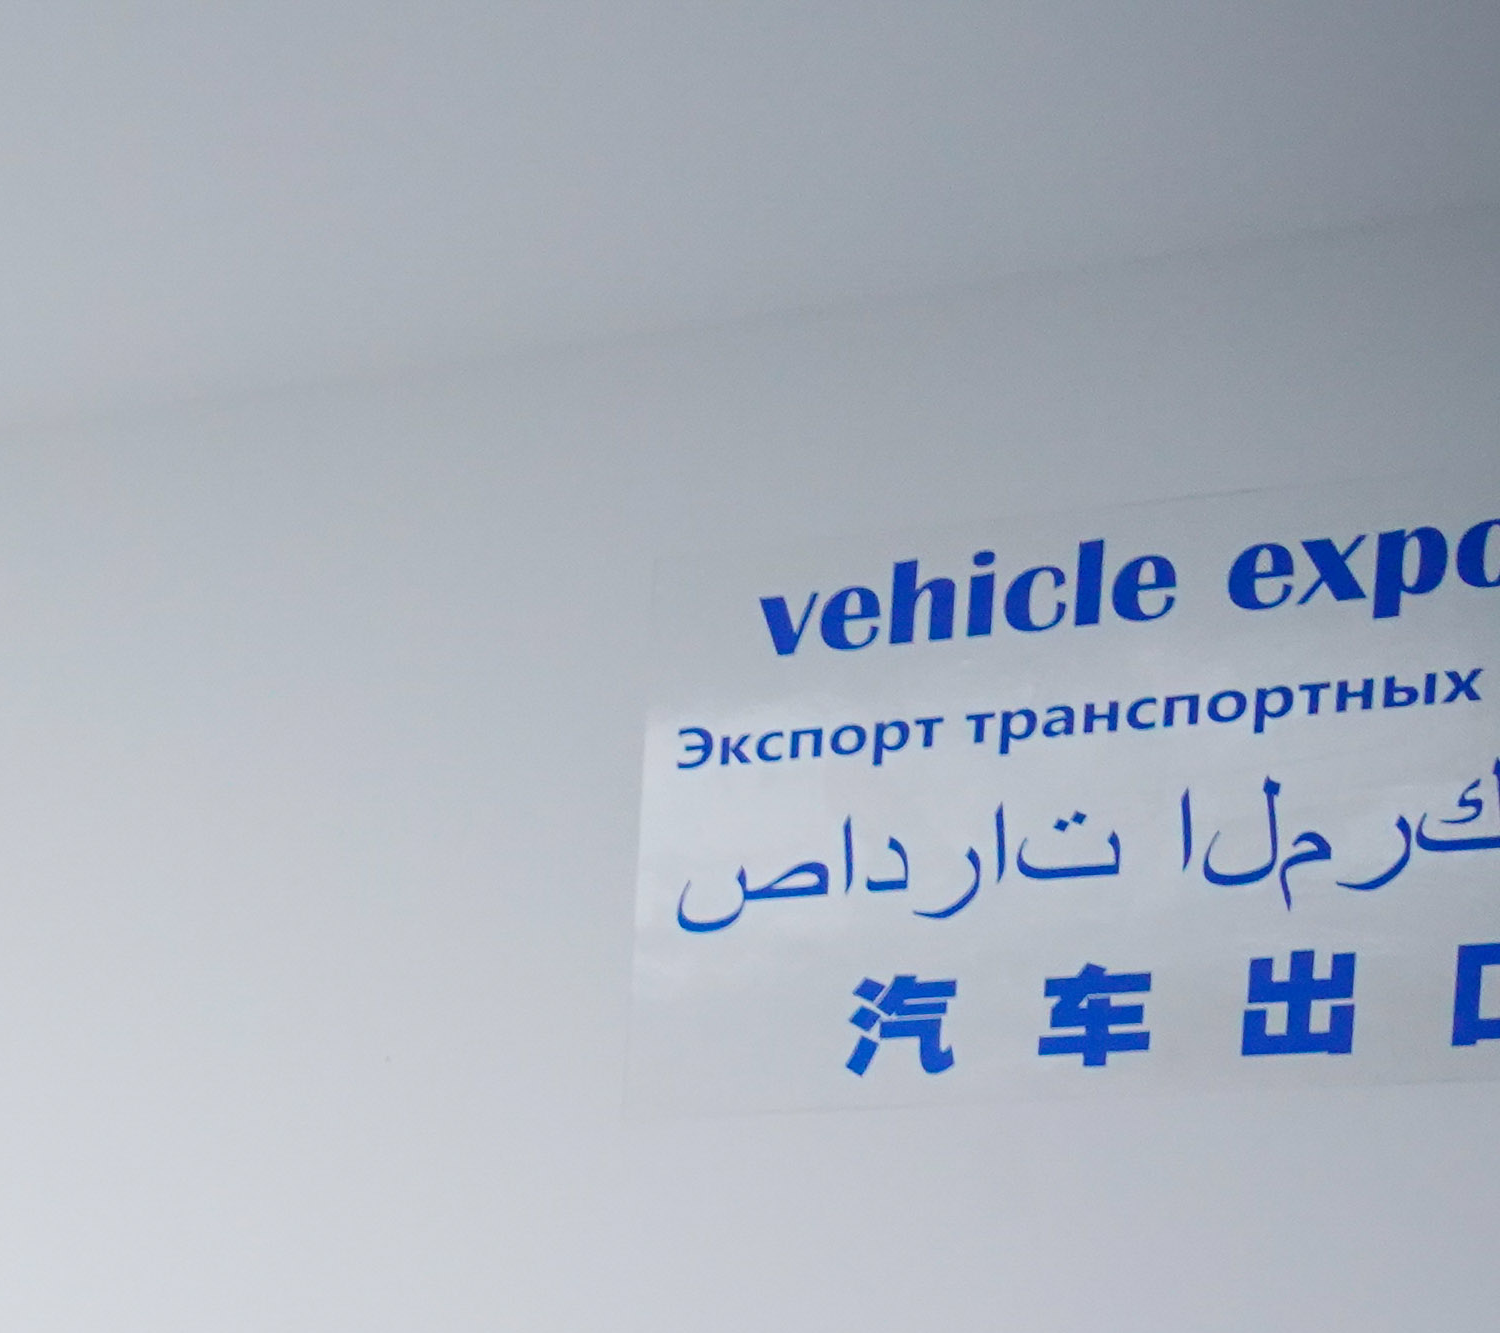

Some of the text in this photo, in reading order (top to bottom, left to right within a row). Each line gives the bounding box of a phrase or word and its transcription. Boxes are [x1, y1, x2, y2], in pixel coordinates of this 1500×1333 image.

[760, 539, 1177, 656] vehicle
[676, 667, 1483, 770] Экспорт транспортных
